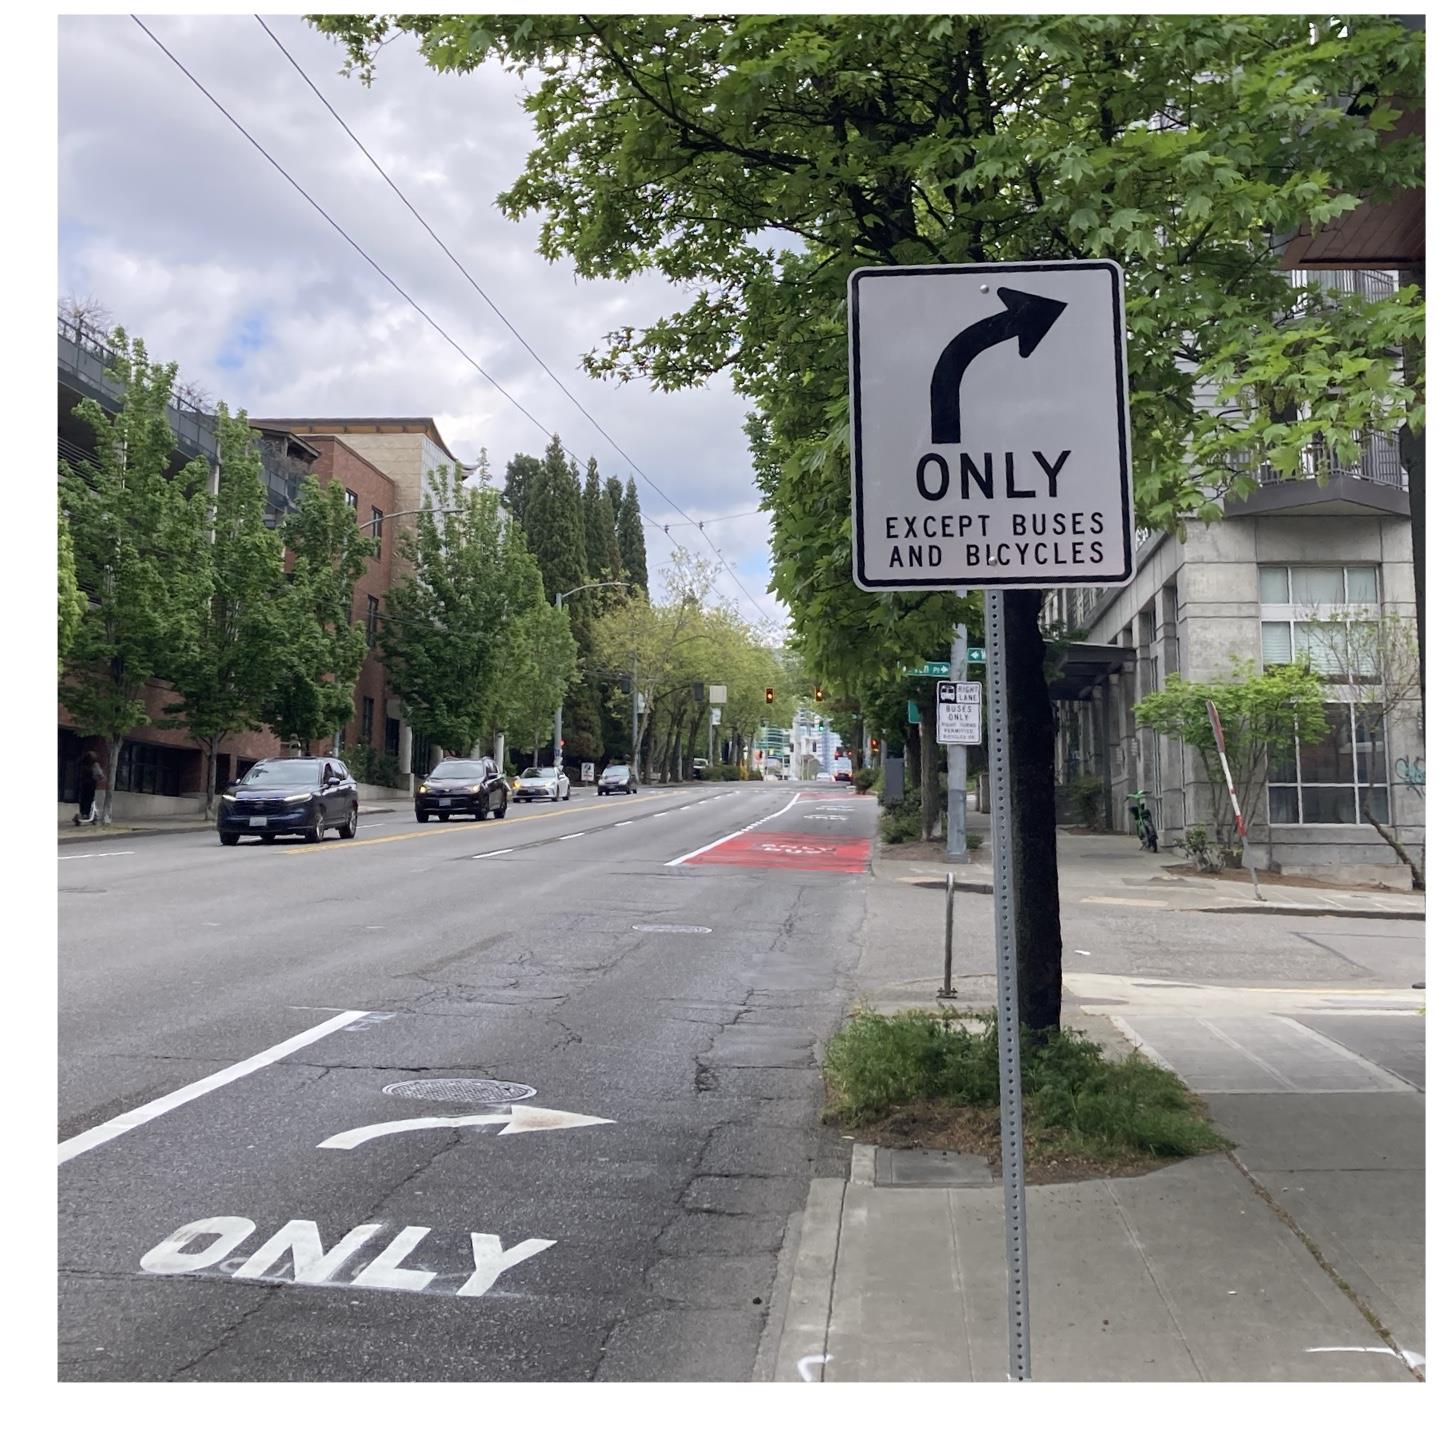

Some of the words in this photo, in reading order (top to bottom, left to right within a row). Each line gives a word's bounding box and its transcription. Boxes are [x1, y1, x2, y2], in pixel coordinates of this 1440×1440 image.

[915, 450, 1072, 502] ONLY
[886, 515, 991, 539] EXCEPT
[1012, 512, 1104, 537] BUSES
[889, 544, 942, 568] AND
[966, 541, 1104, 567] BICYCLES
[139, 1215, 558, 1297] ONLY
